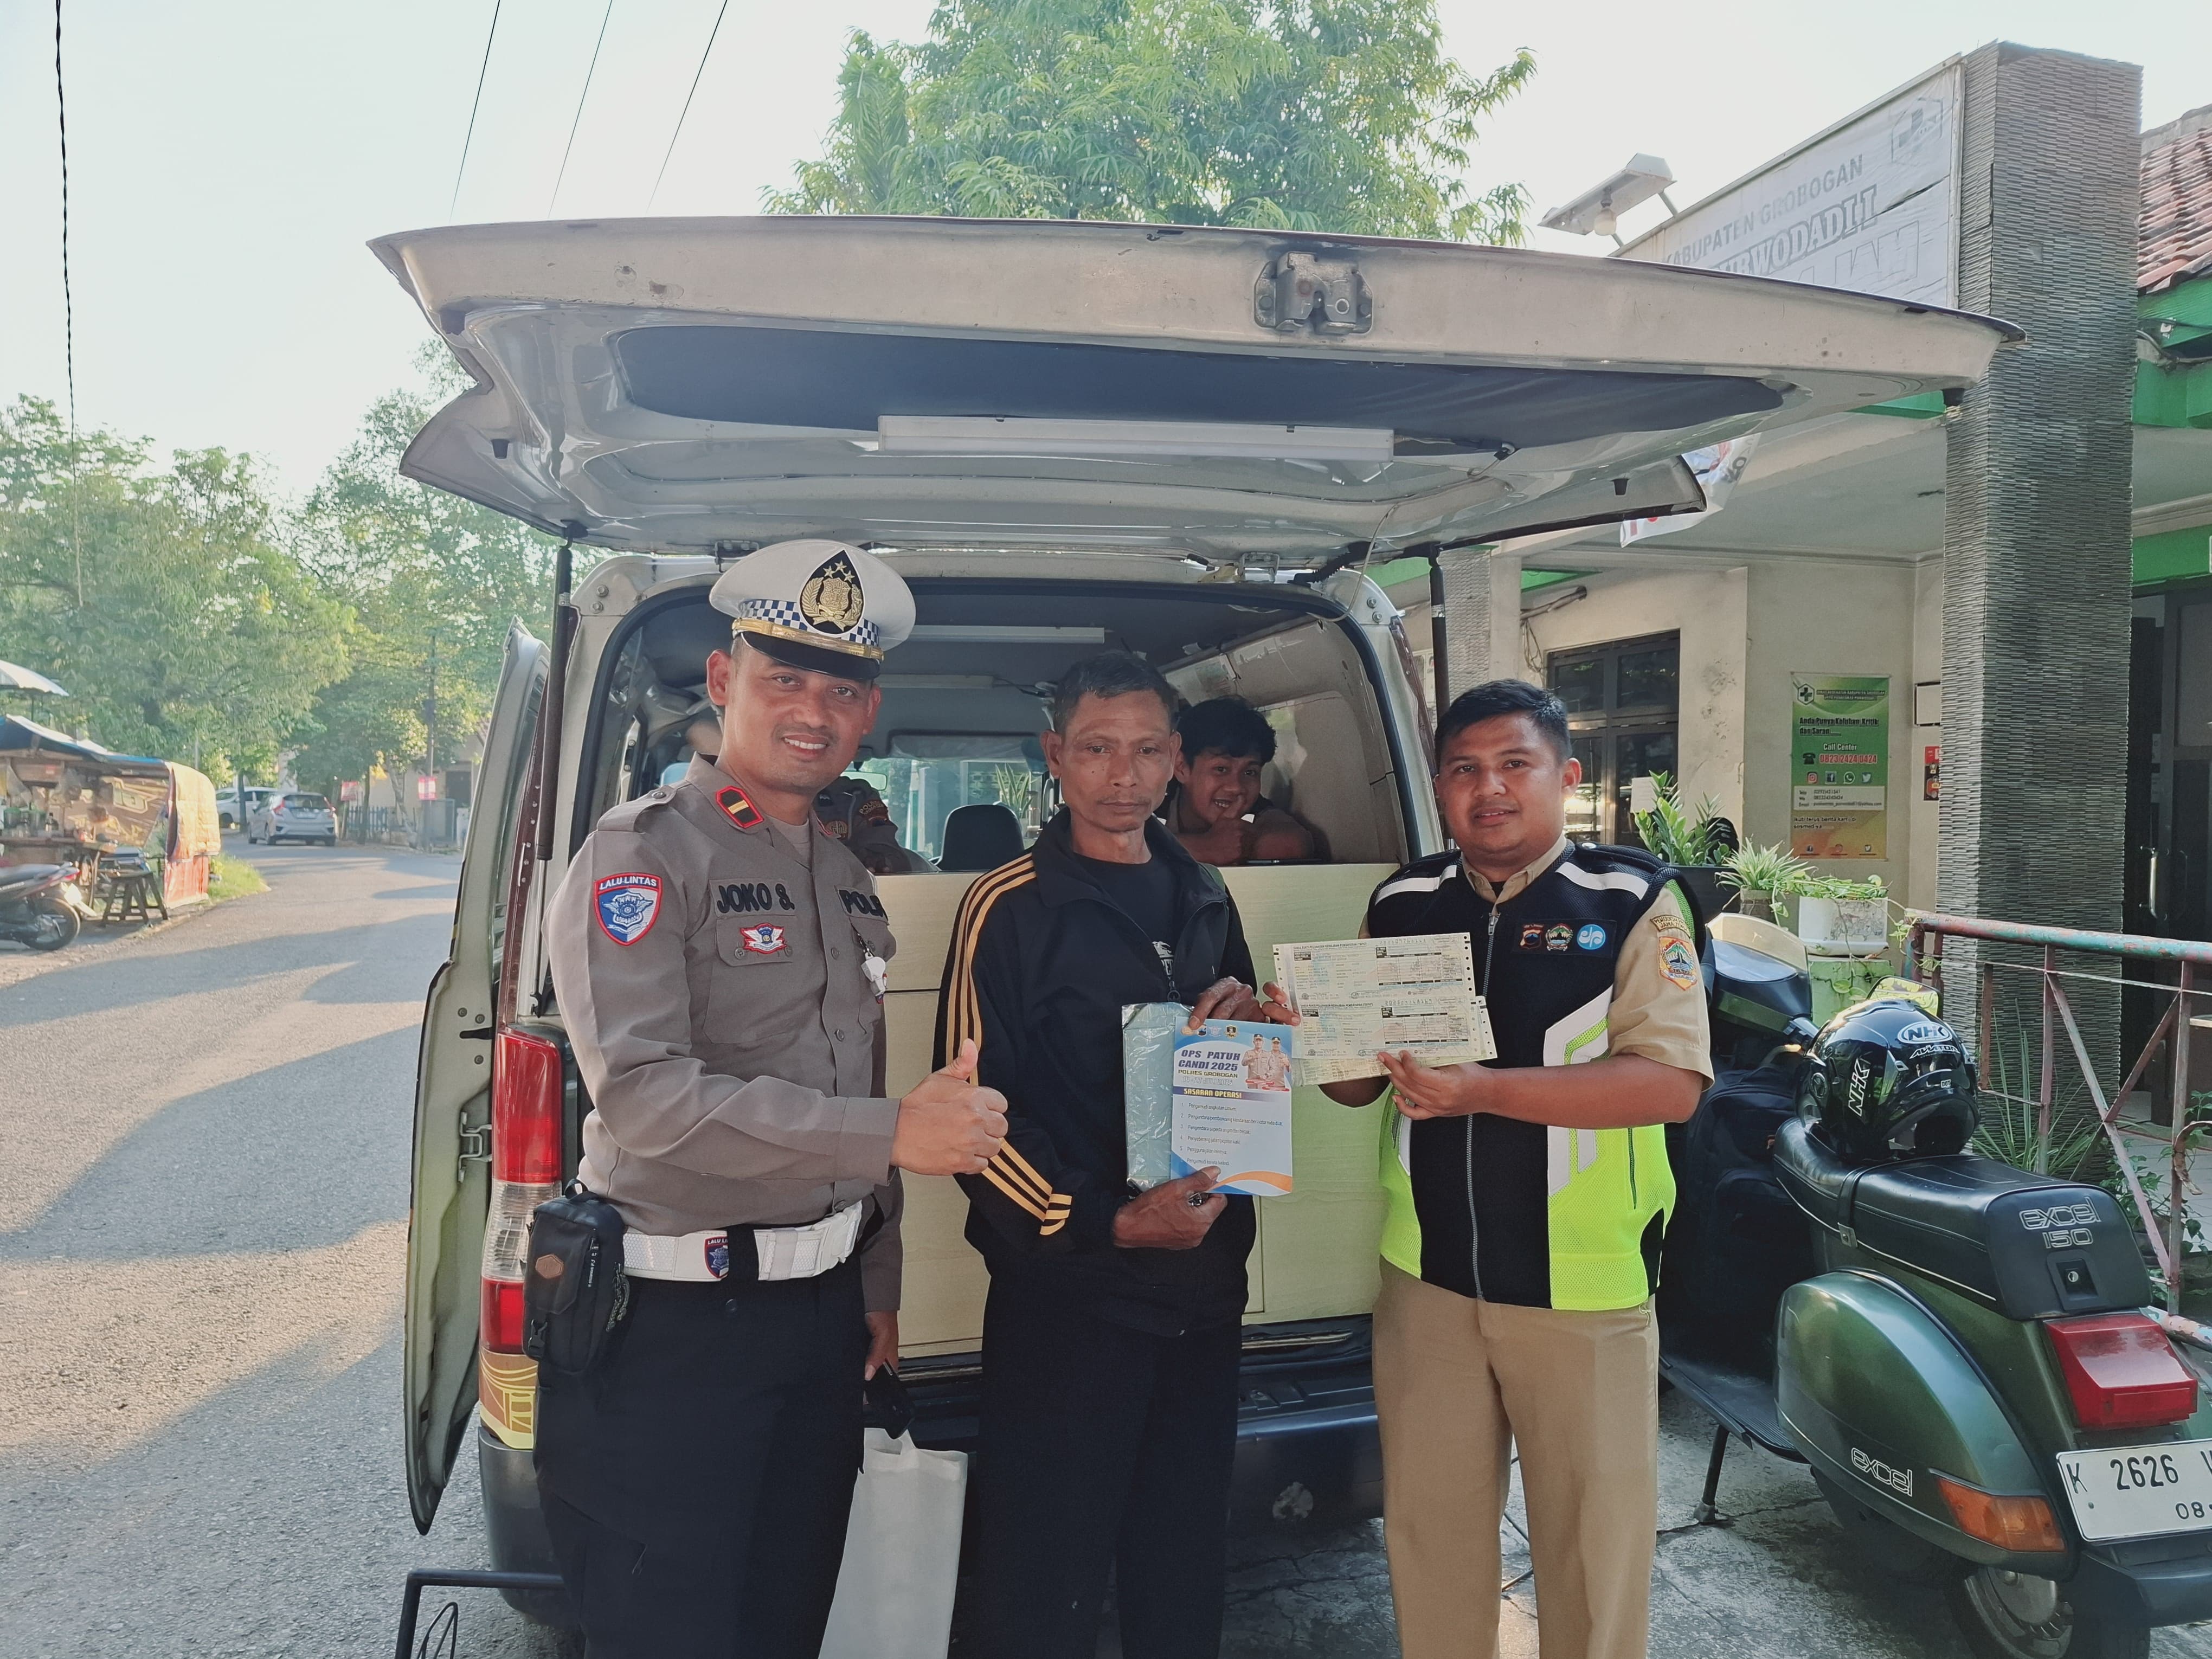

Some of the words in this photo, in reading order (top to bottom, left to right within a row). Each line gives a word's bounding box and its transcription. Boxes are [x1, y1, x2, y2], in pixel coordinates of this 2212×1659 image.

[1761, 154, 1862, 225] GROBOGAN
[1799, 717, 1815, 725] Anda
[1816, 718, 1834, 726] Punya
[717, 883, 772, 914] JOKO
[1908, 1026, 1947, 1040] NHK
[1178, 1059, 1209, 1069] CANDI
[1210, 1062, 1238, 1071] 2025
[1181, 1050, 1201, 1058] OPS
[1207, 1051, 1240, 1061] PATUH
[1184, 1088, 1213, 1096] SASARAN
[1214, 1090, 1242, 1098] OPERASI
[1848, 1058, 1870, 1117] NHK
[2019, 1195, 2101, 1230] excel
[2042, 1227, 2094, 1249] 150
[1851, 1447, 1913, 1497] excel
[2066, 1462, 2088, 1495] K
[2110, 1454, 2179, 1491] 2626
